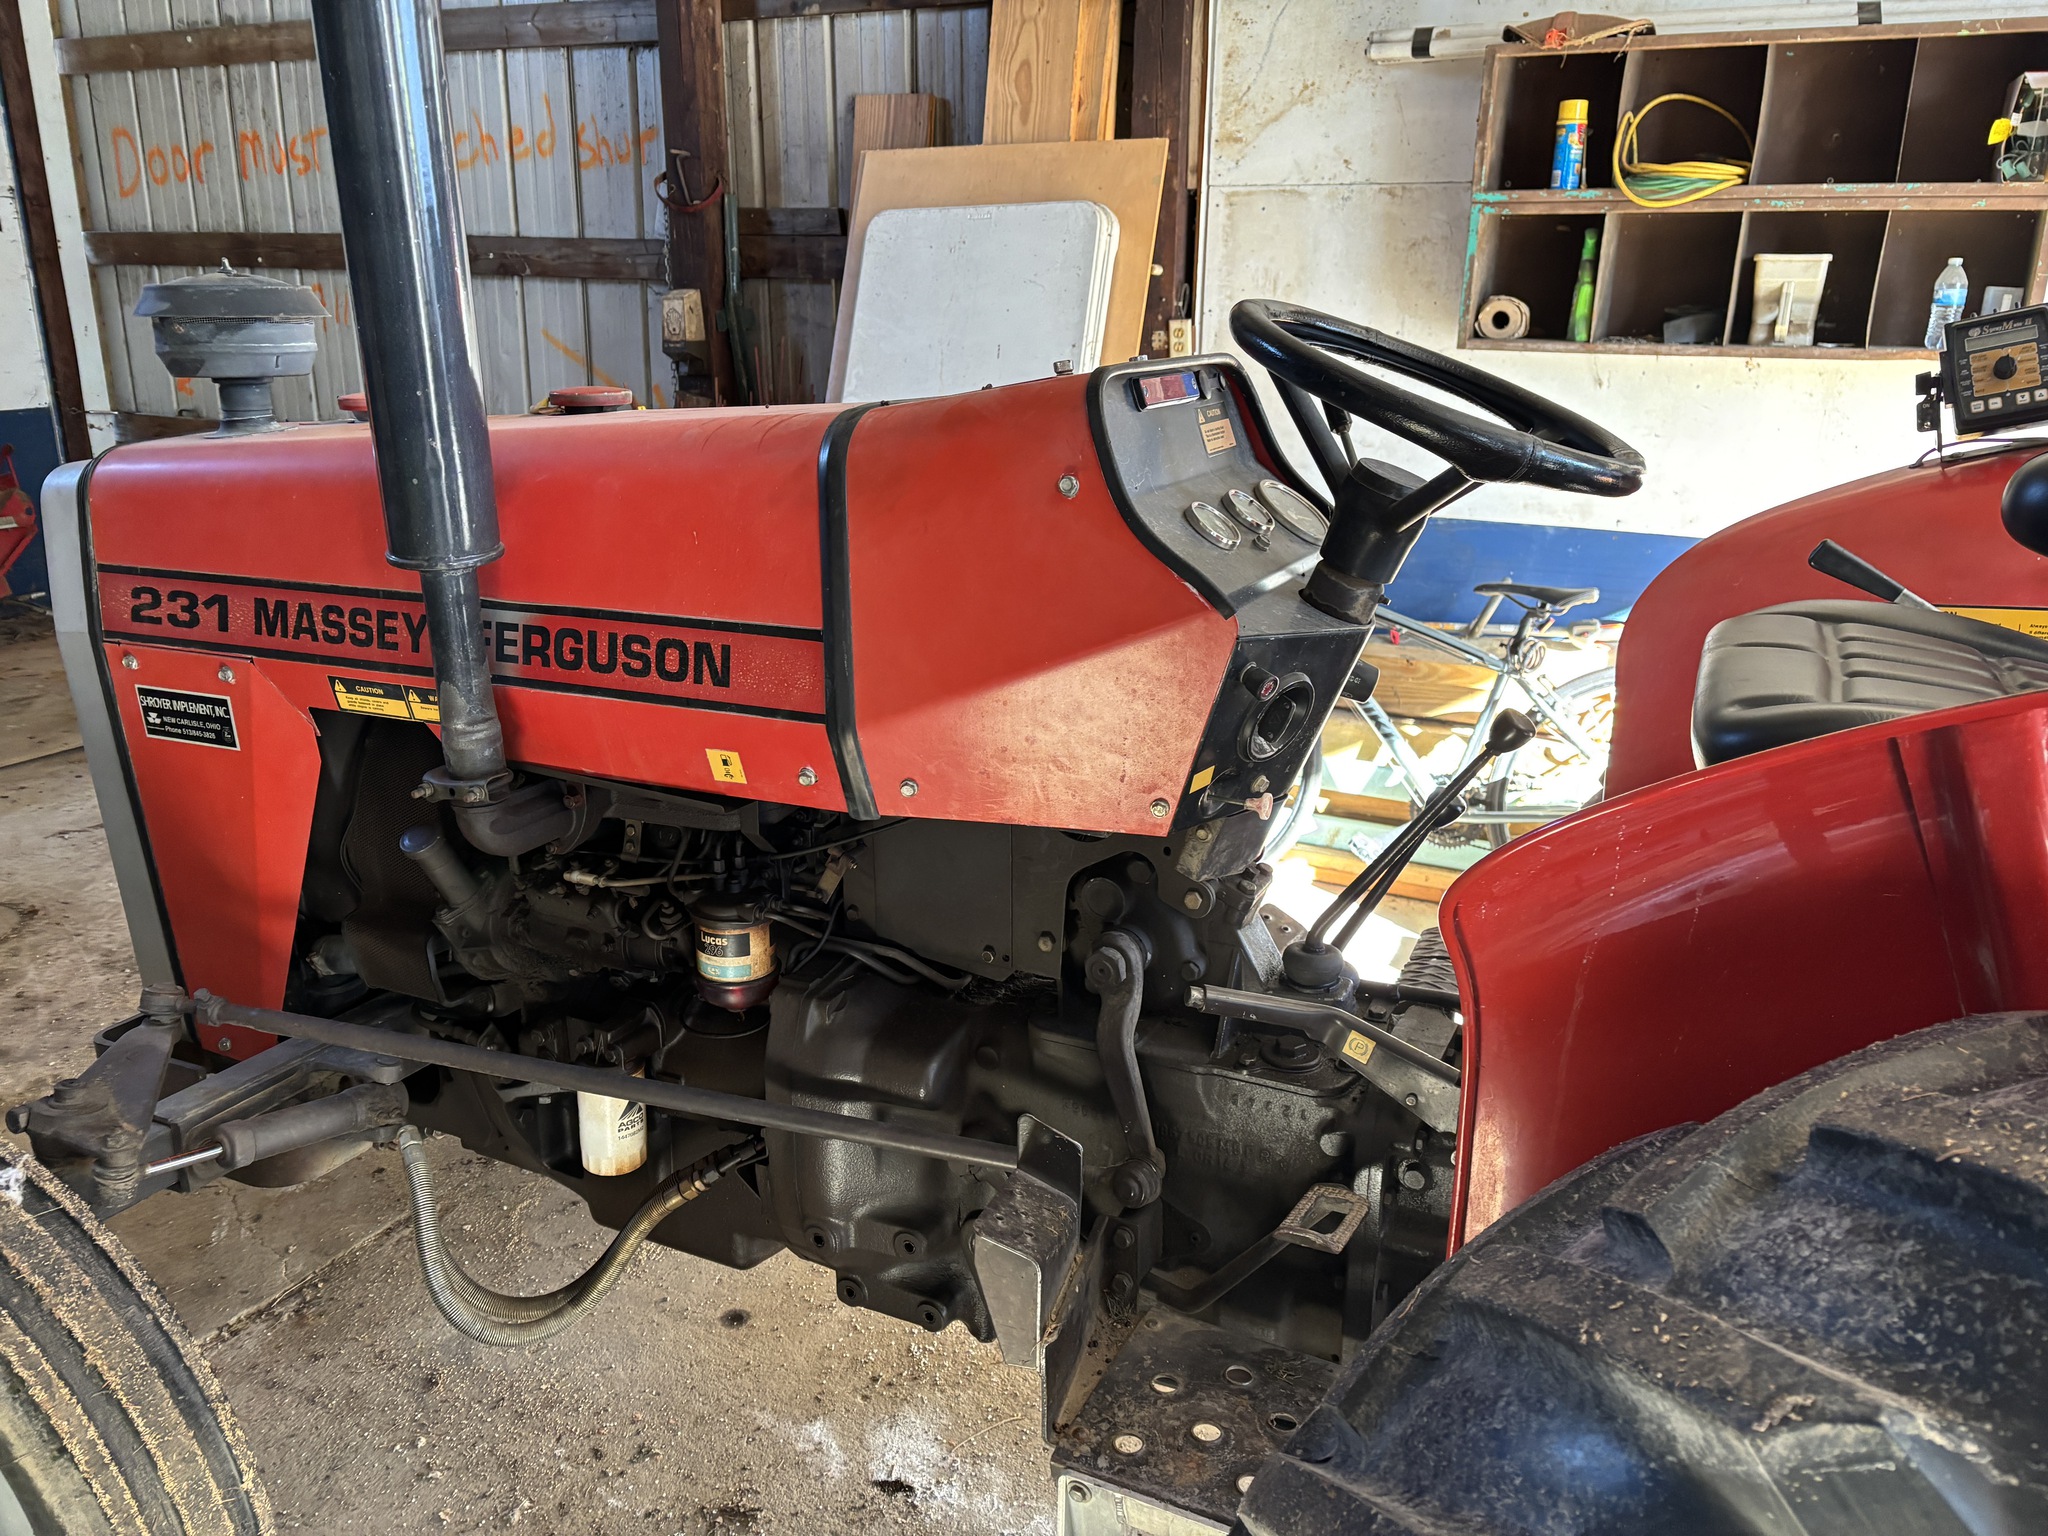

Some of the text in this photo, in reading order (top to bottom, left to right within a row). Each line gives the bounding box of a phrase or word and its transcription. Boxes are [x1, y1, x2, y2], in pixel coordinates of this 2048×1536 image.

[112, 126, 214, 198] Door
[454, 93, 557, 170] ched
[130, 586, 229, 633] 231
[253, 597, 427, 653] MASSEY
[355, 685, 384, 695] CAUTION
[140, 695, 172, 710] SHROYER
[162, 716, 177, 724] NEW
[205, 722, 221, 731] OHIO
[164, 725, 182, 734] Phone
[700, 931, 728, 946] Lucas
[703, 943, 724, 957] 296
[617, 1112, 644, 1128] AGCO
